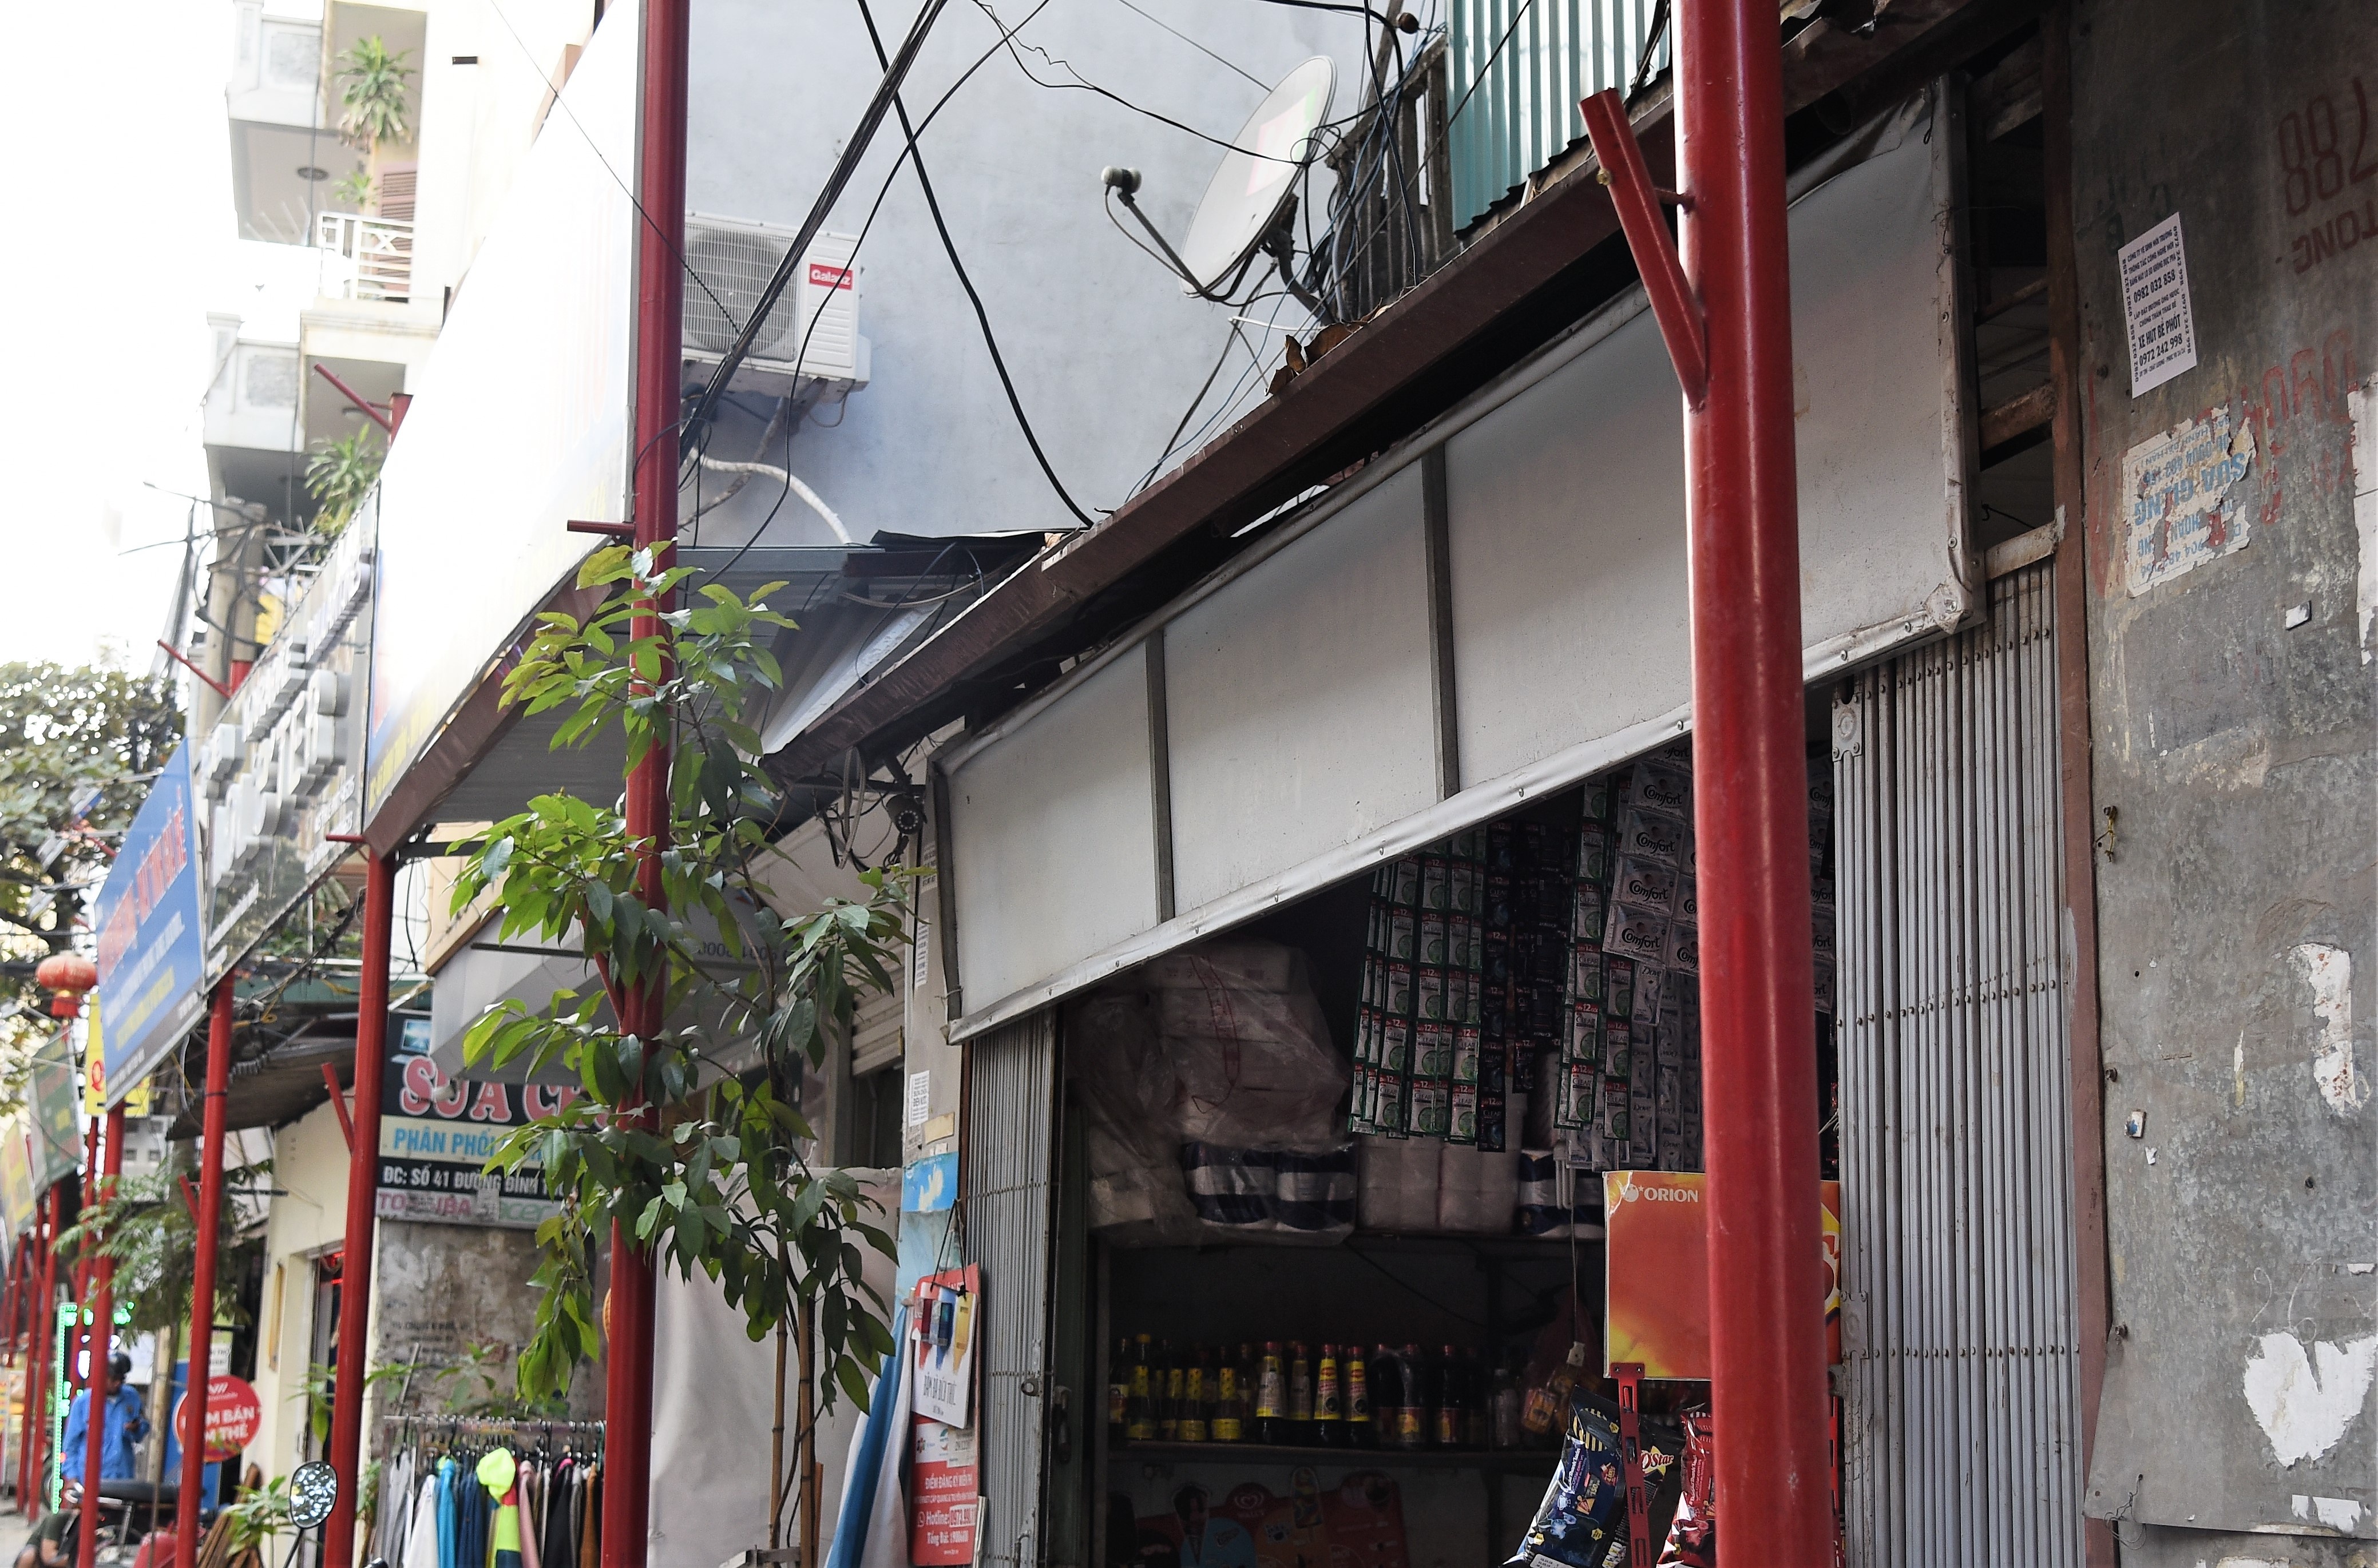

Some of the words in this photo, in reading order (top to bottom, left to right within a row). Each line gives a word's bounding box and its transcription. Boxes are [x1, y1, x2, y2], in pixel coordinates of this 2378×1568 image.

[2133, 284, 2149, 304] 0982
[2150, 276, 2162, 294] 032
[2162, 268, 2175, 286] 858
[2138, 333, 2145, 350] XE
[2138, 347, 2155, 367] 0972
[2155, 340, 2169, 358] 242
[2169, 332, 2183, 350] 998
[1643, 784, 1682, 808] Comfort
[1636, 831, 1675, 854] Comfort
[1629, 879, 1668, 902] Comfort
[1622, 927, 1660, 950] Comfort
[394, 1126, 446, 1153] PHÂN
[384, 1165, 407, 1186] ĐC:
[410, 1162, 432, 1186] SỐ
[433, 1170, 449, 1189] 41
[1644, 1186, 1698, 1202] ORION
